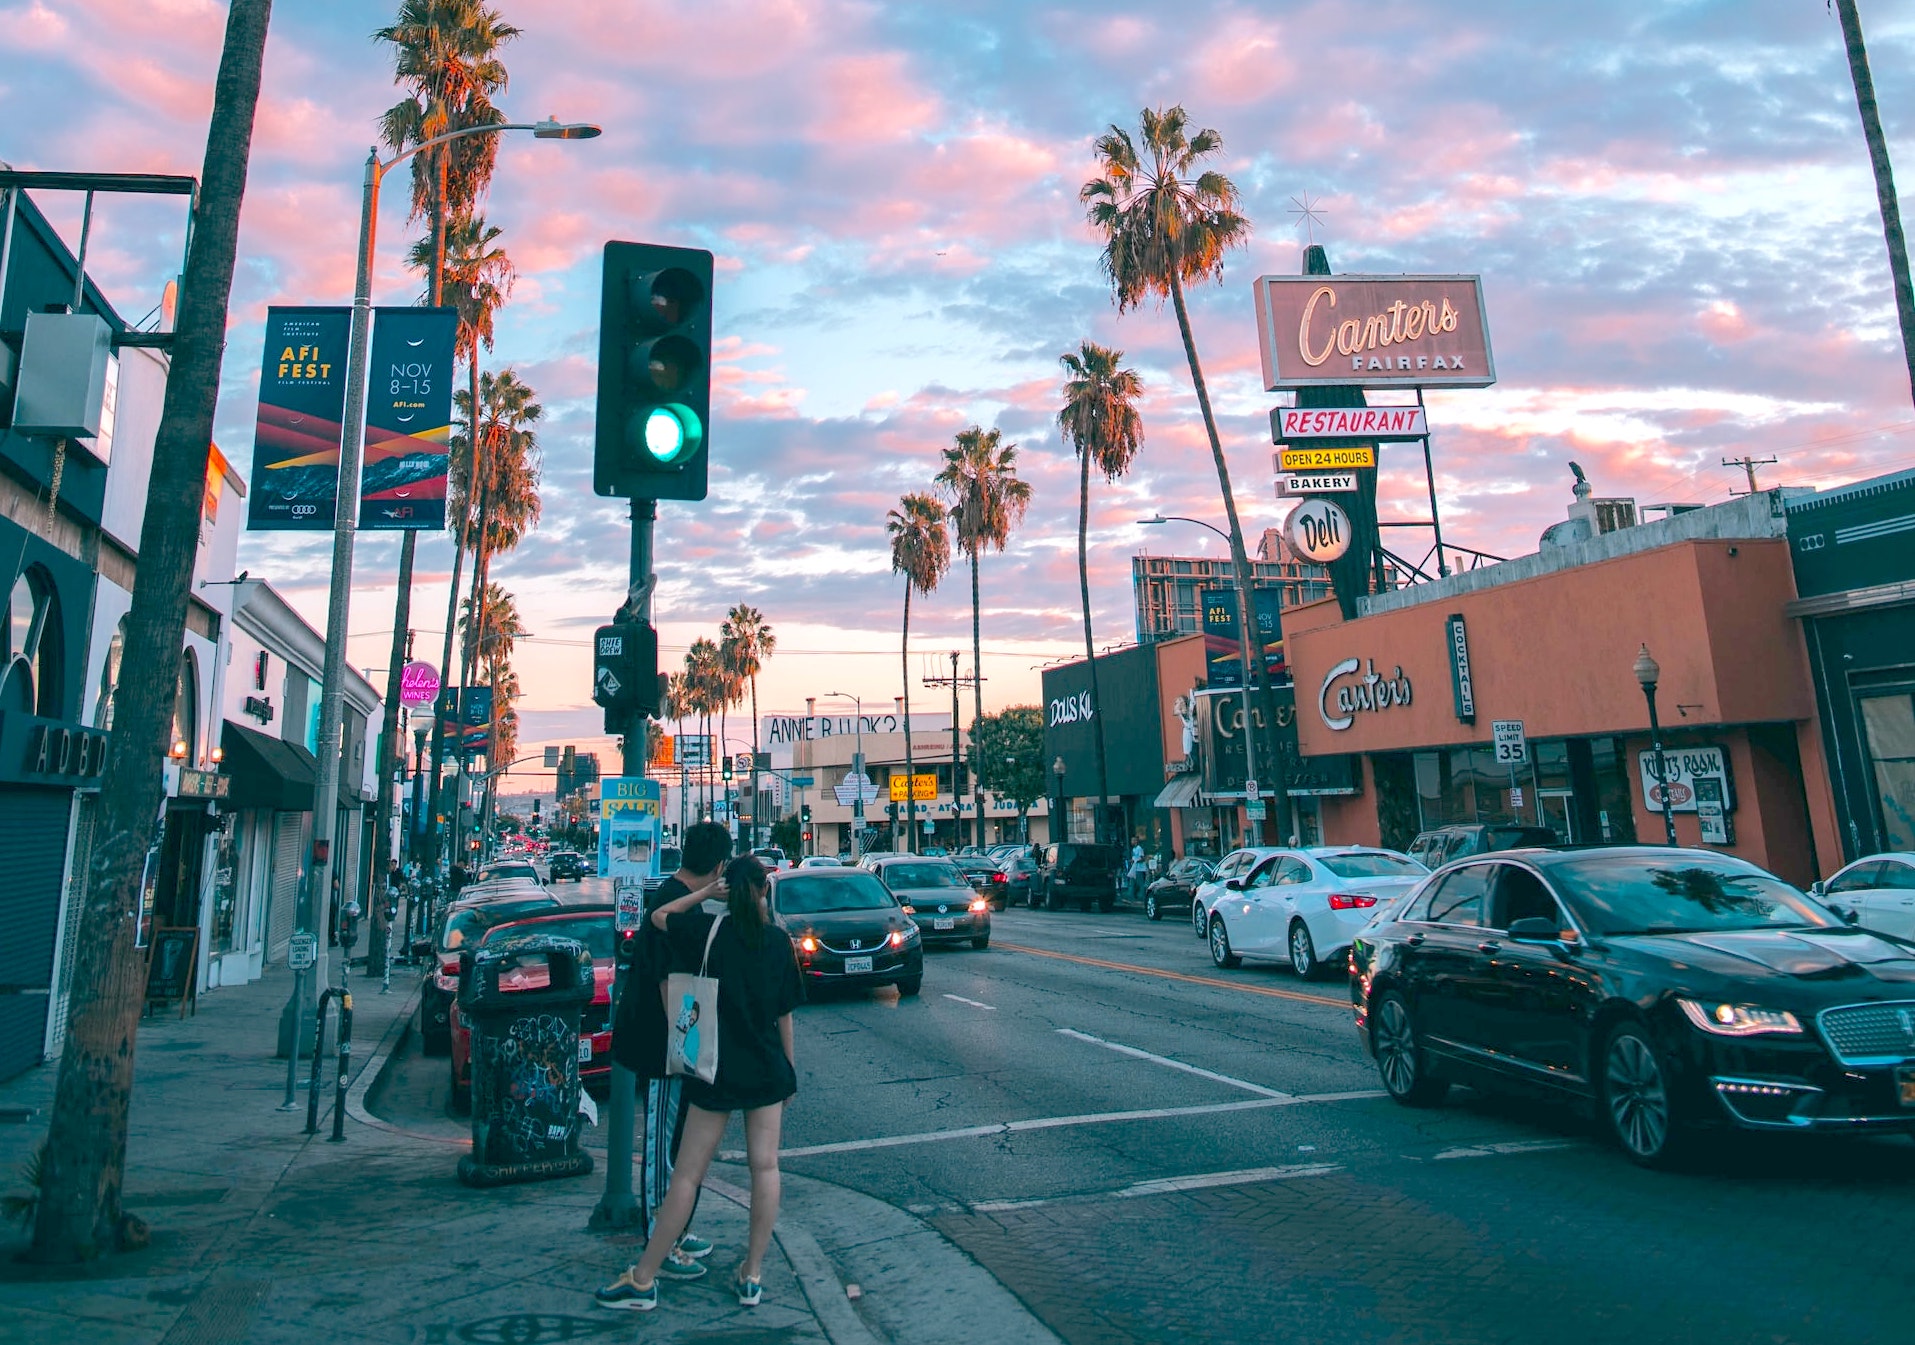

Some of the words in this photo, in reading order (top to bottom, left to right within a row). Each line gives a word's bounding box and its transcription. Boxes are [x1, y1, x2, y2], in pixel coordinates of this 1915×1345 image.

[280, 346, 319, 361] AFI
[391, 363, 433, 378] NOV
[1352, 355, 1466, 371] FAIRFAX
[277, 363, 332, 379] FEST
[1285, 410, 1420, 433] RESTAURANT
[1285, 454, 1312, 466] OPEN
[1314, 453, 1332, 465] 24
[1334, 451, 1369, 464] HOURS
[1290, 477, 1351, 489] BAKERY
[1299, 506, 1341, 553] Deli
[1209, 607, 1225, 615] AFI
[1209, 615, 1231, 623] FEST
[1455, 626, 1473, 713] COCKTAILS
[401, 666, 440, 689] helen's
[403, 691, 431, 700] WINES
[1319, 658, 1413, 731] Canter's
[1050, 696, 1078, 728] DOLLS
[1215, 697, 1296, 738] Caner
[1495, 723, 1522, 732] SPEED
[1498, 733, 1520, 741] LIMIT
[1499, 744, 1524, 760] 35
[1642, 754, 1681, 782] KITZ
[1683, 753, 1720, 777] ROOM
[893, 776, 934, 788] Cater's
[617, 783, 647, 797] BIG
[898, 790, 930, 799] PAKING
[884, 804, 928, 814] CAAD
[938, 801, 975, 812] ATRA'
[993, 798, 1039, 810] JUDAA
